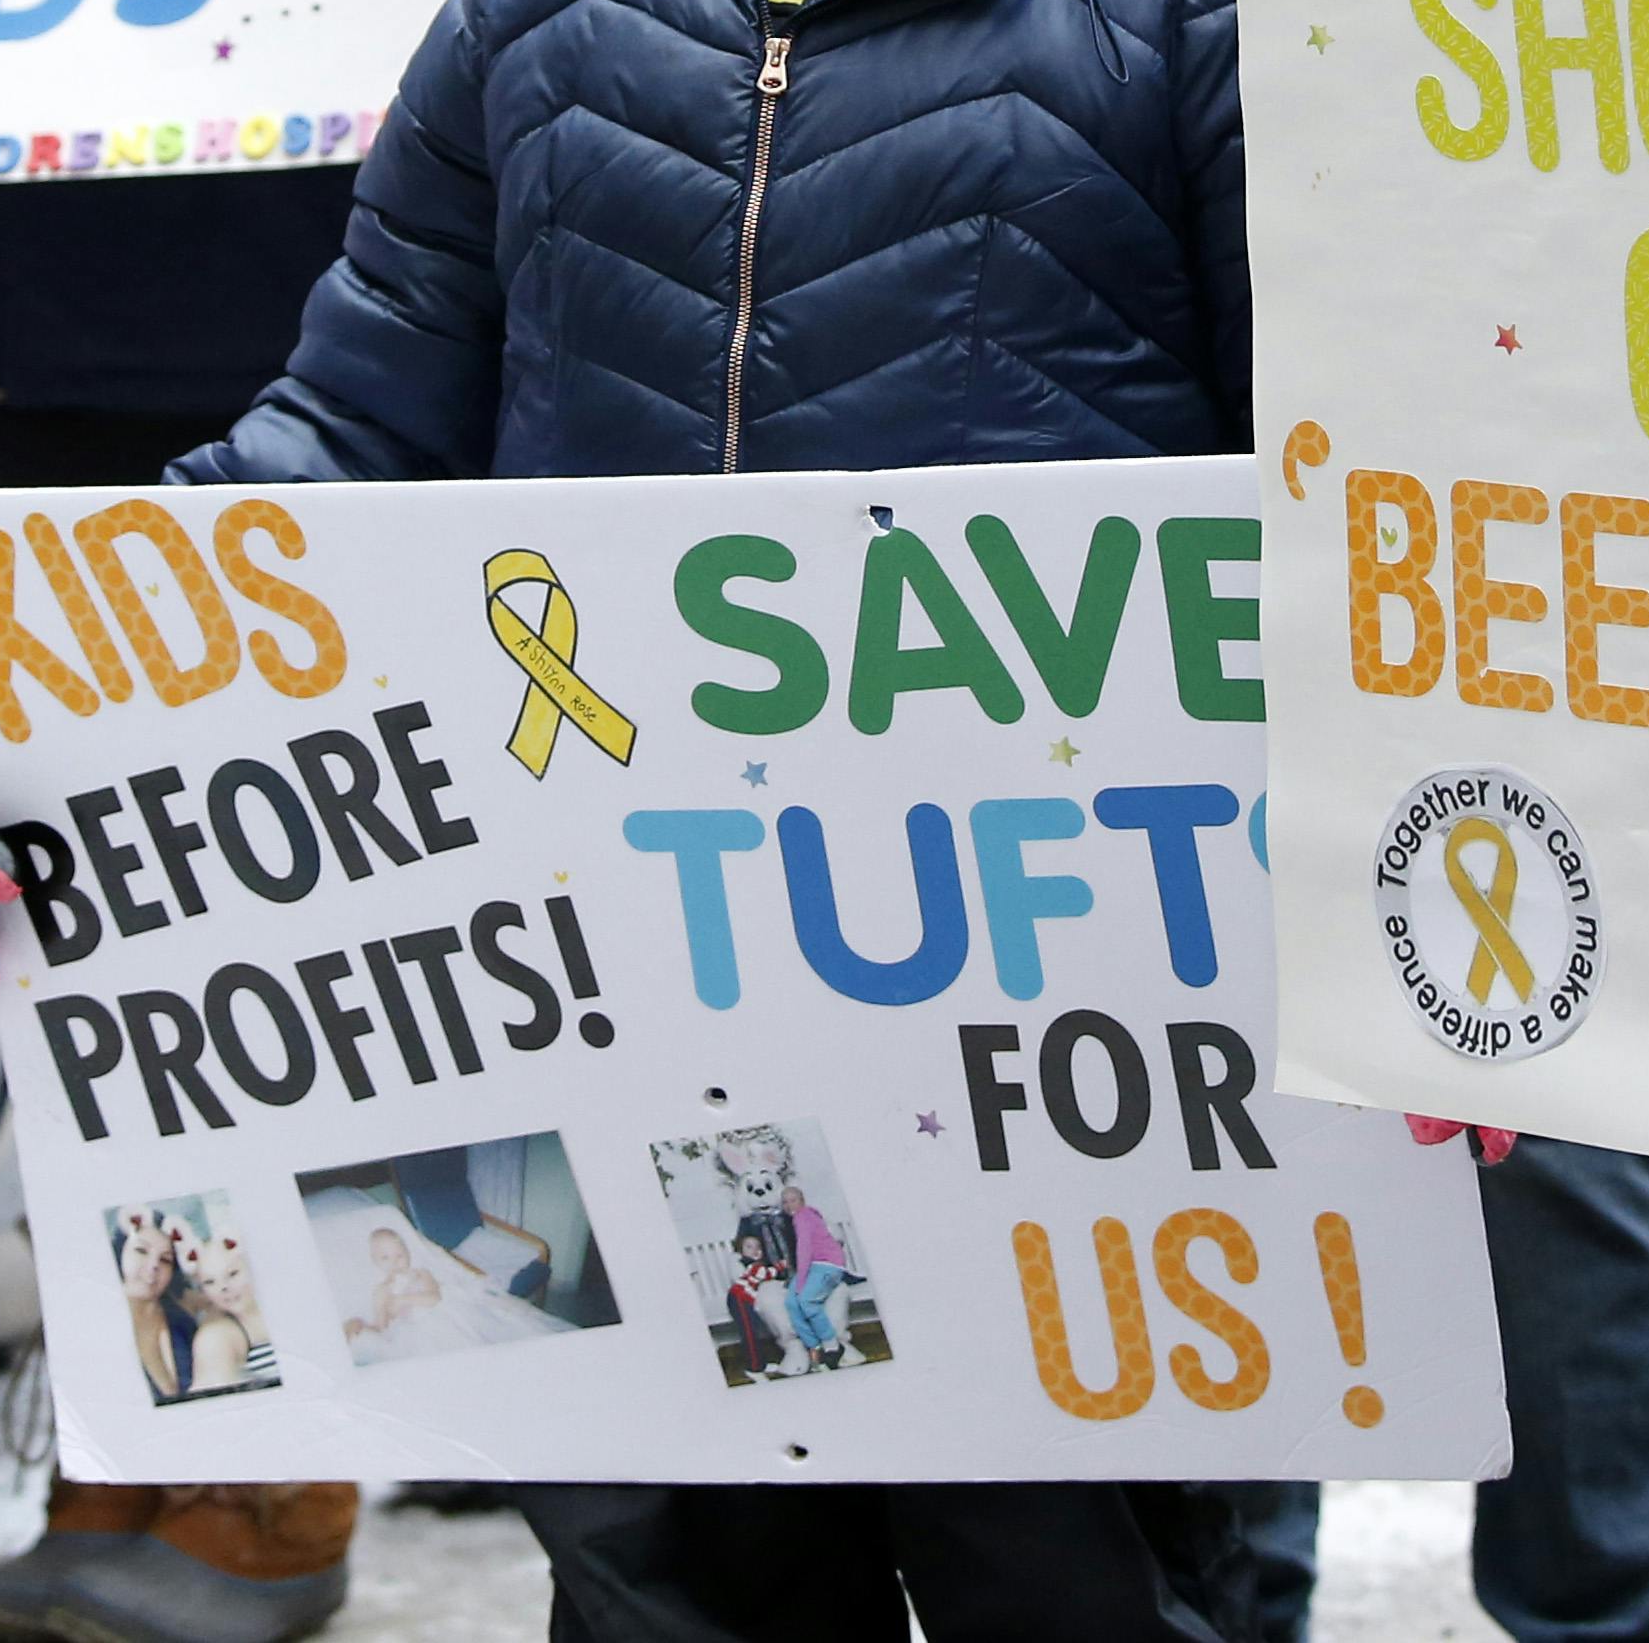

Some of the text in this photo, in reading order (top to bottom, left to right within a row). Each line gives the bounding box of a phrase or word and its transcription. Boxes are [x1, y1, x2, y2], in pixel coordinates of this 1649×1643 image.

[674, 514, 1266, 735] SAVE
[622, 782, 1269, 1010] TUFT
[1378, 779, 1597, 1057] Together we can make a difference
[35, 895, 616, 1142] PROFITS!
[957, 1009, 1277, 1171] FOR
